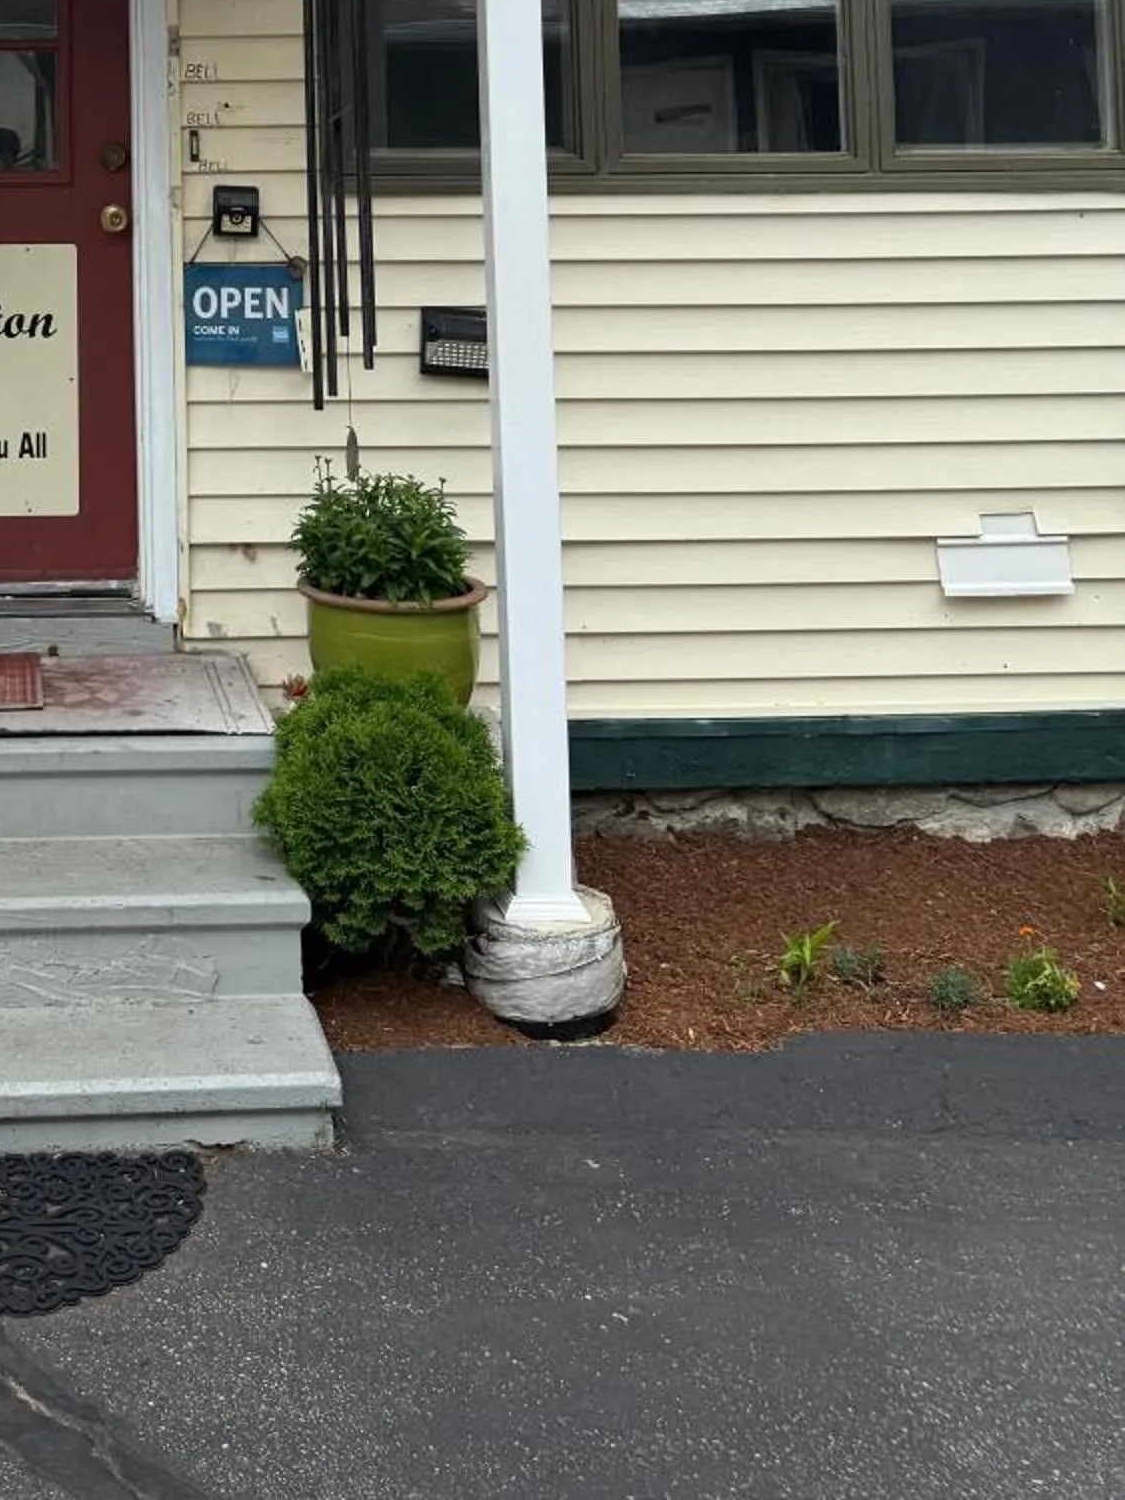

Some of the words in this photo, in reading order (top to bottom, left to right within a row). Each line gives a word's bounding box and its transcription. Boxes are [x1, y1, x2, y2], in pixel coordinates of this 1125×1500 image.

[192, 286, 289, 319] OPEN
[194, 325, 226, 335] COME
[228, 325, 240, 335] IN
[18, 432, 47, 458] All
